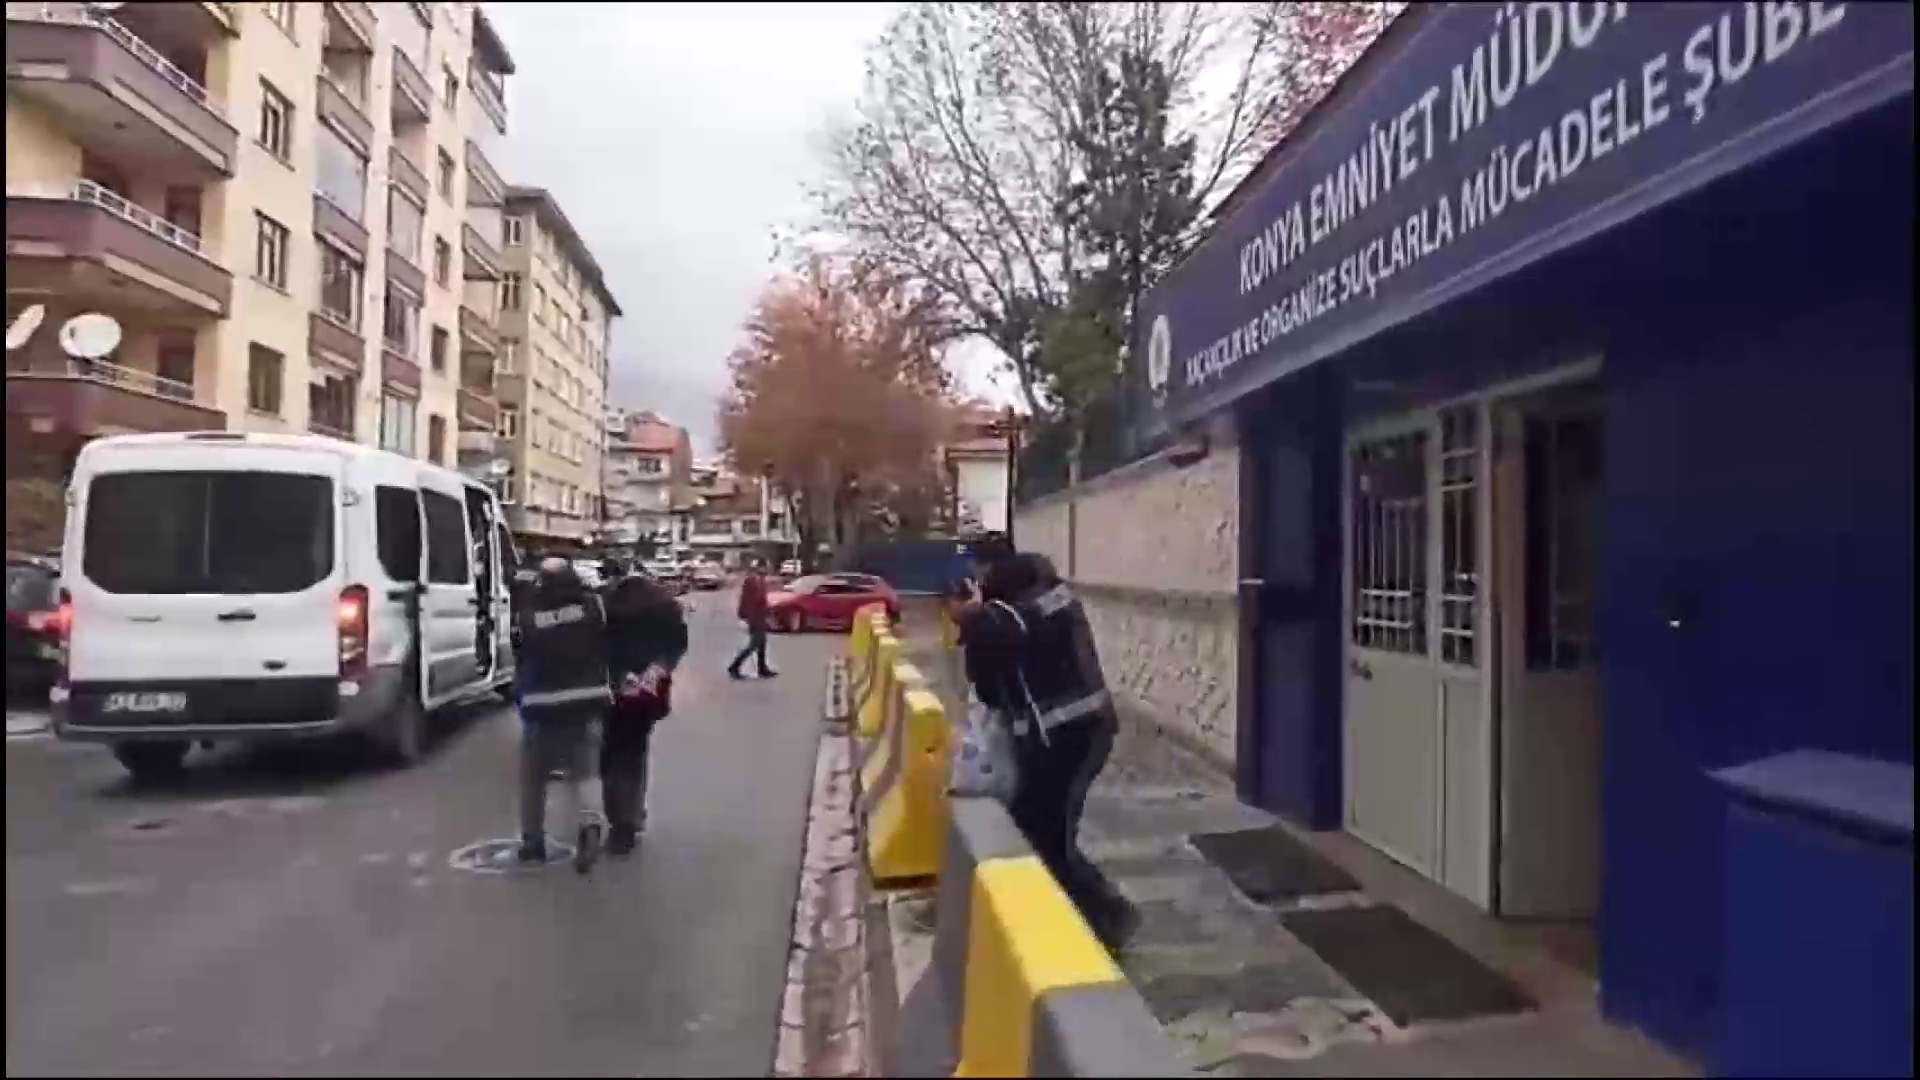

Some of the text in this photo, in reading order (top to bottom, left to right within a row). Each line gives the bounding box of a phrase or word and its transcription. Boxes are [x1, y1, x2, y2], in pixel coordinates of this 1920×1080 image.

[1240, 2, 1627, 295] KONYA EMNİYET MÜD
[1339, 195, 1454, 302] SUÇLARLA
[1460, 52, 1671, 234] MÜCADELE
